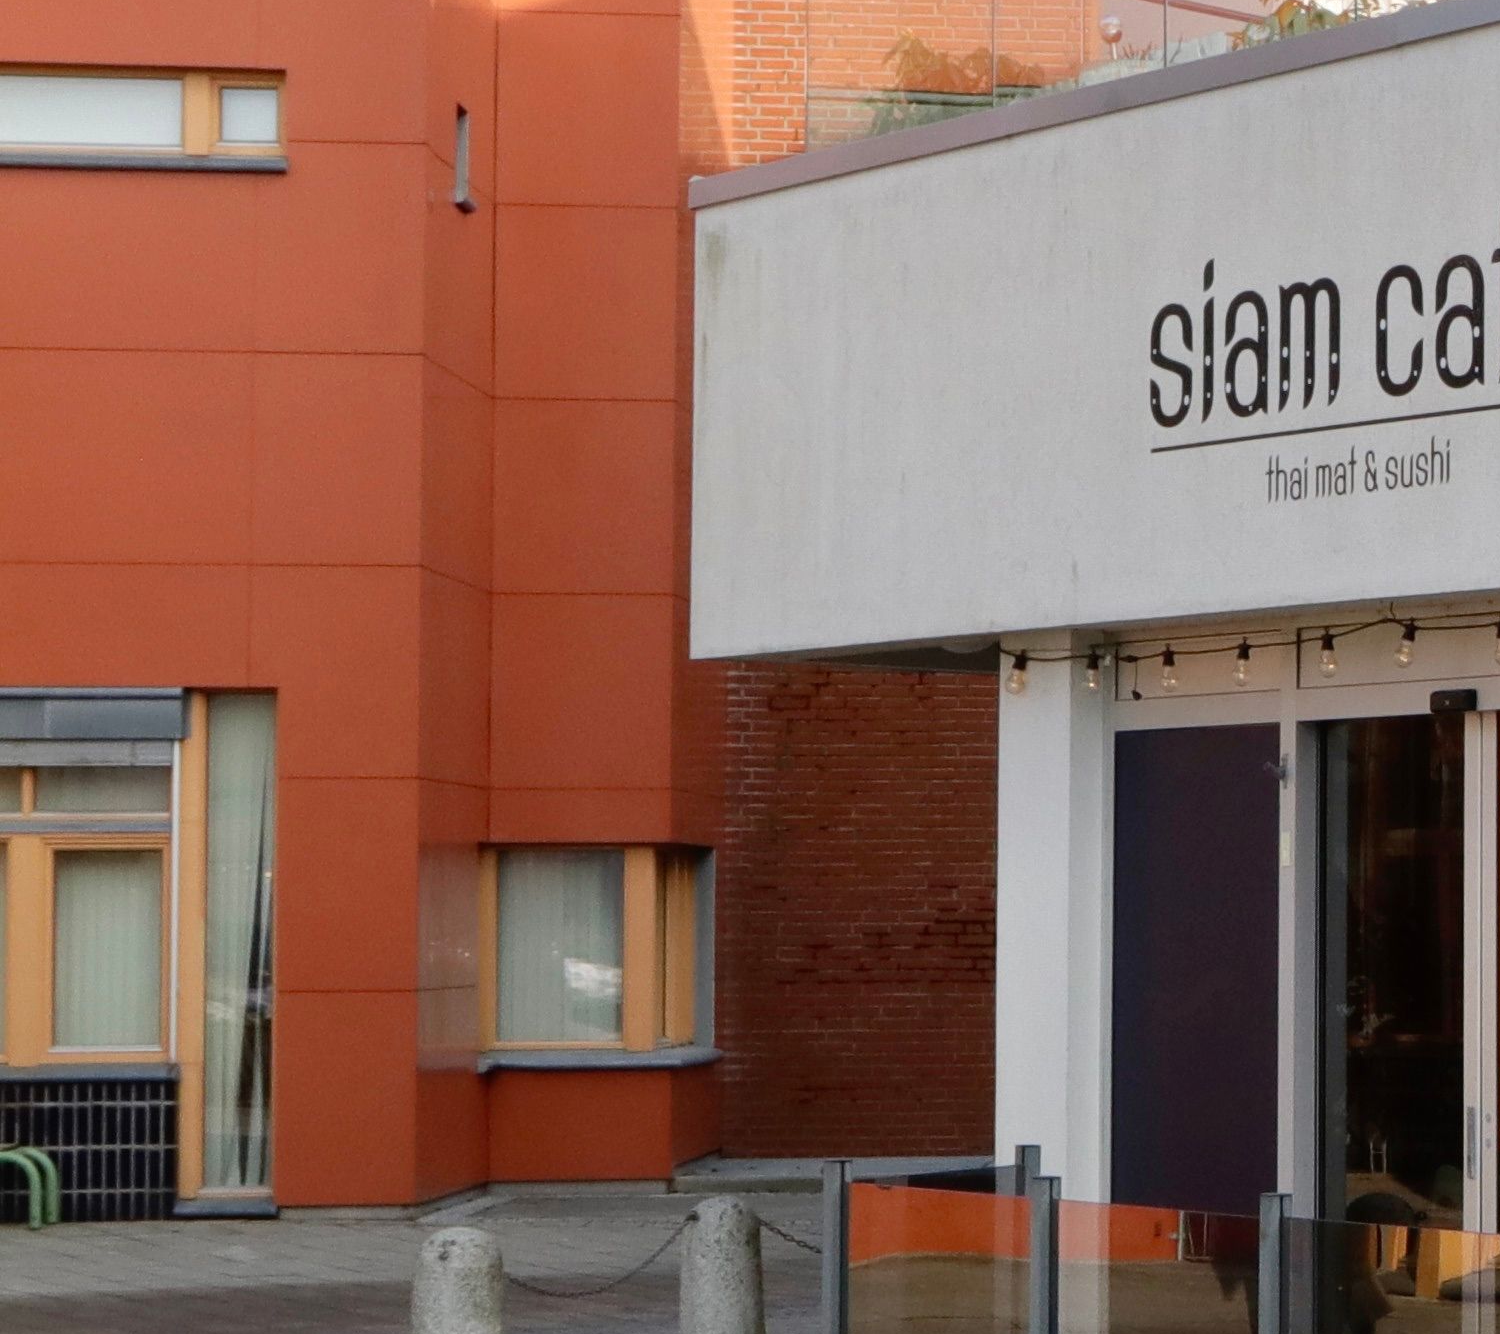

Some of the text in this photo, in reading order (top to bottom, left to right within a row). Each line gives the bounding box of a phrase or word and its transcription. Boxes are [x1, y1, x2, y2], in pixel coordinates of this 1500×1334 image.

[1149, 257, 1342, 429] siam
[1265, 435, 1451, 504] thai mat & sushi
